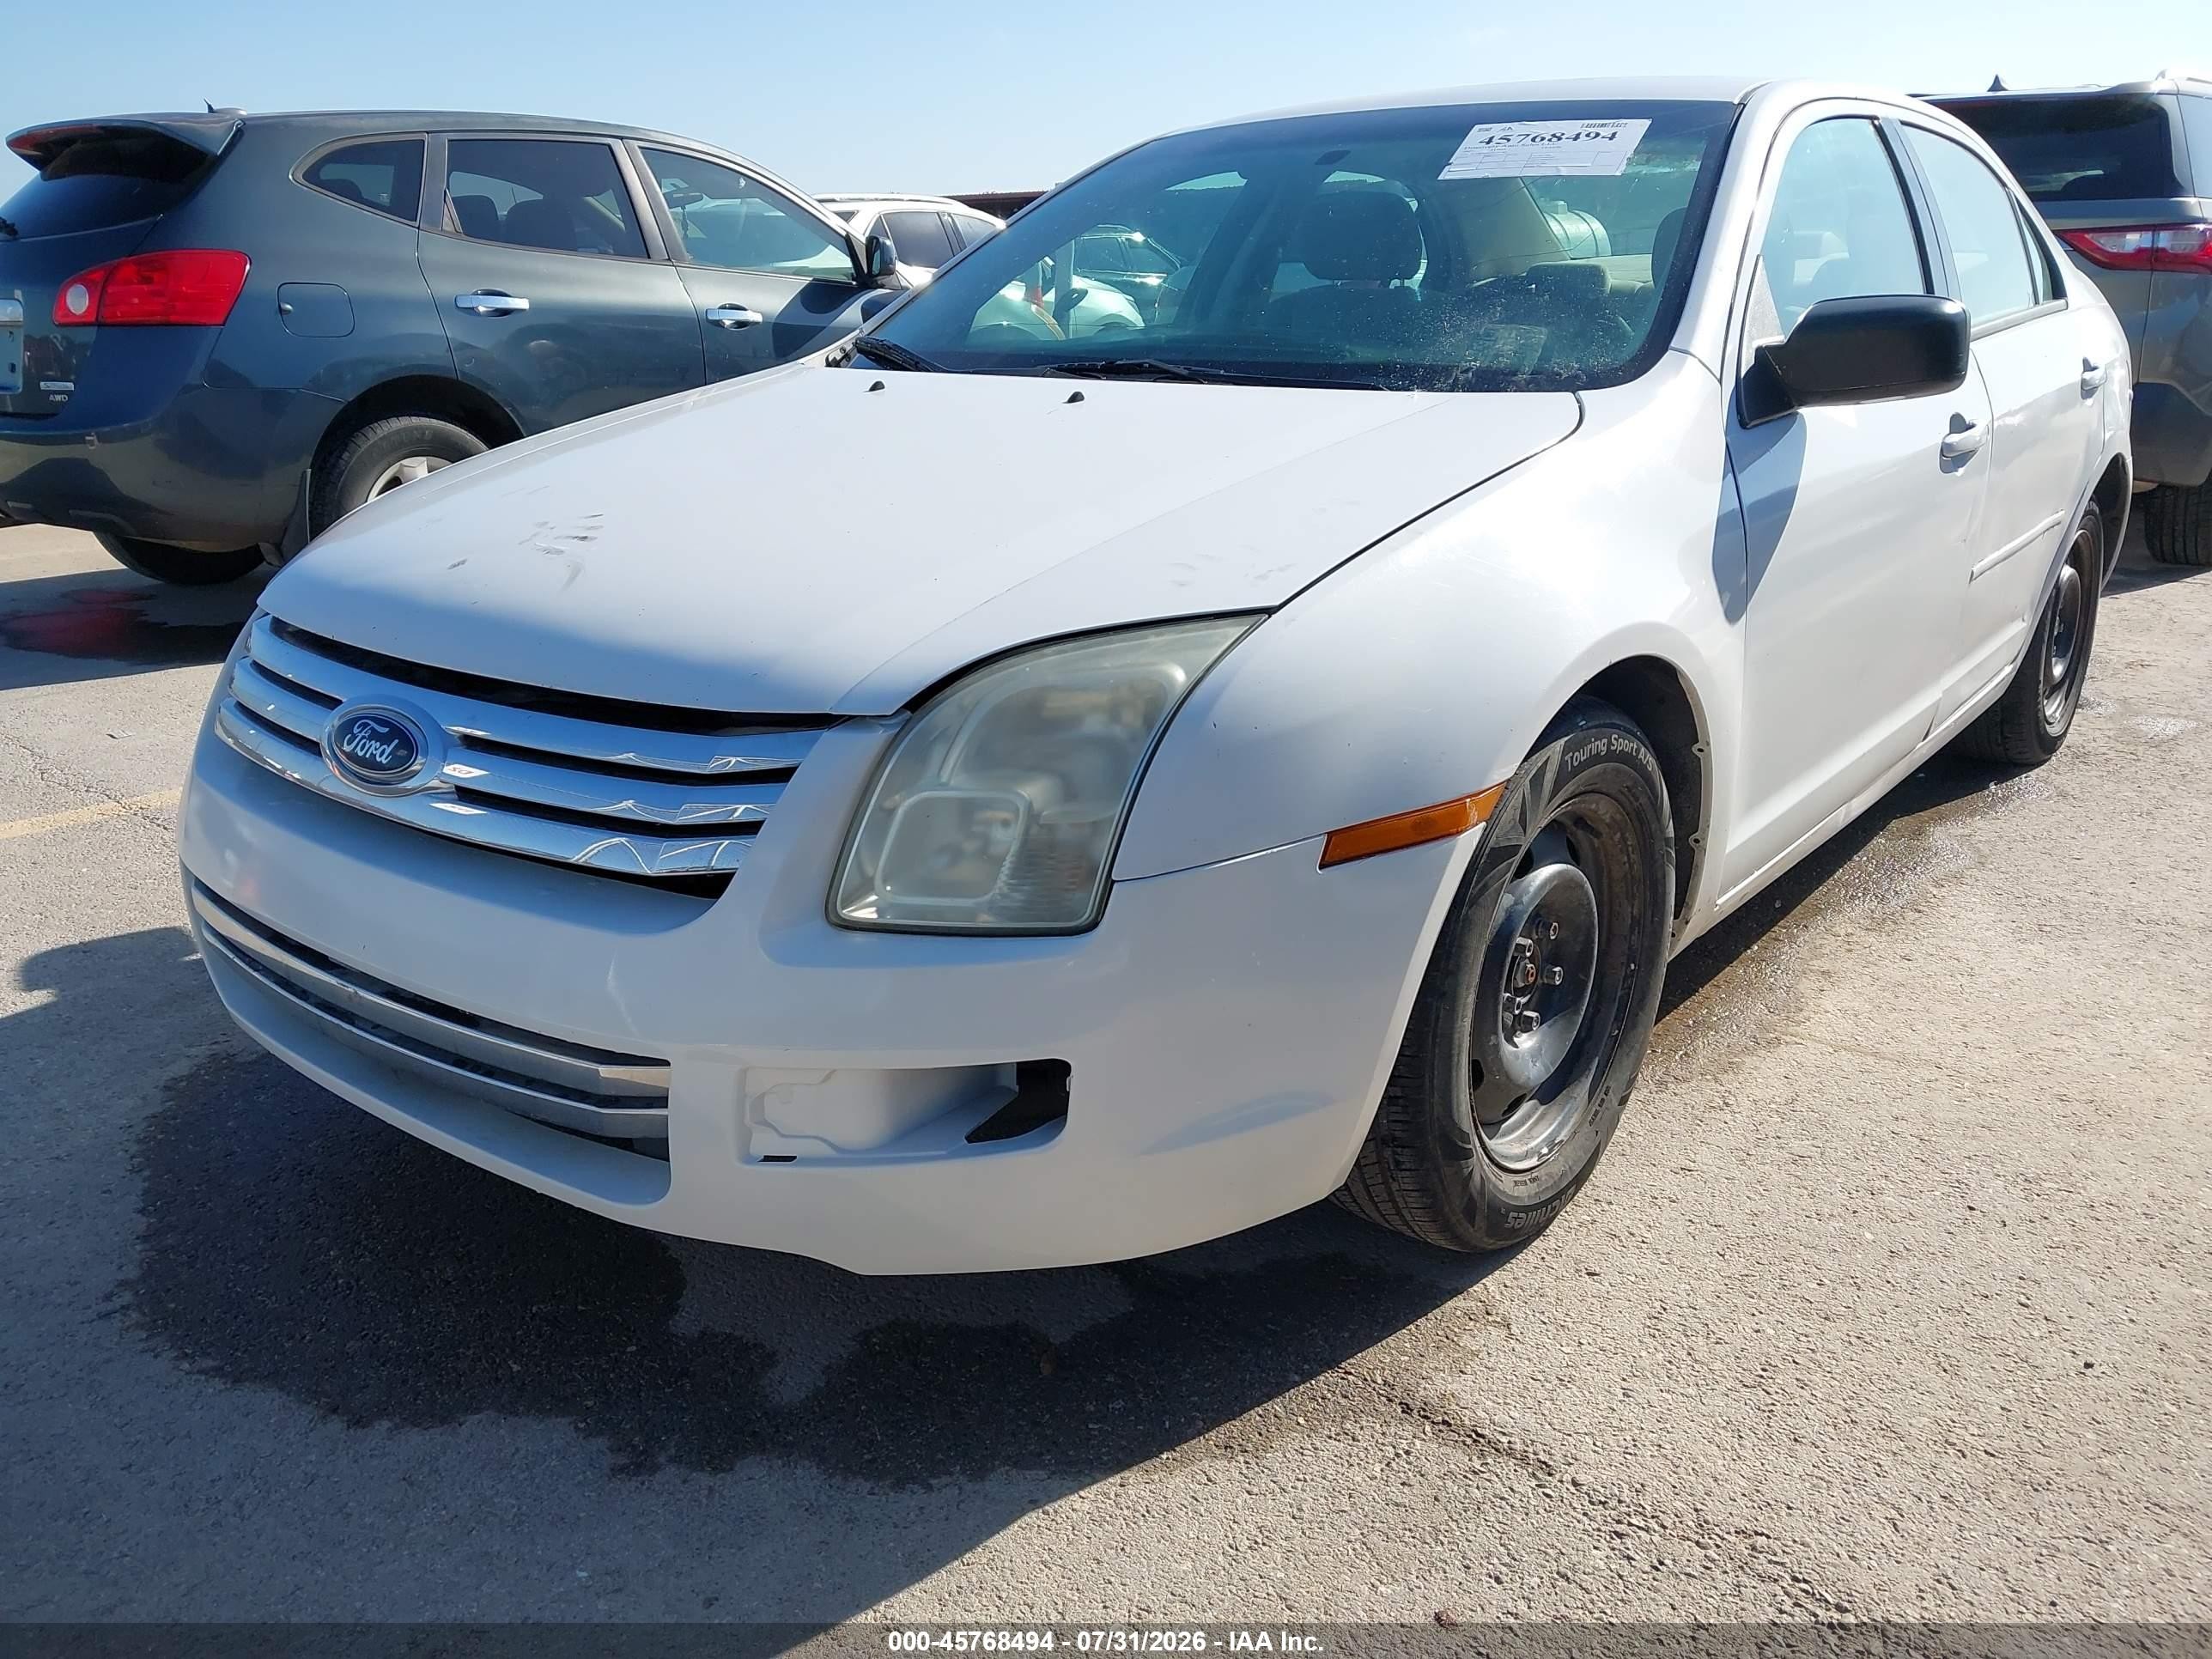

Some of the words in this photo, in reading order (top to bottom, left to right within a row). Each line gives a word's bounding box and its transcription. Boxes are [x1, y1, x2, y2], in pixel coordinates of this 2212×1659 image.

[1478, 131, 1619, 145] 45768494
[343, 719, 399, 764] Ford
[1565, 738, 1608, 772] Touring
[1610, 733, 1638, 757] Sport
